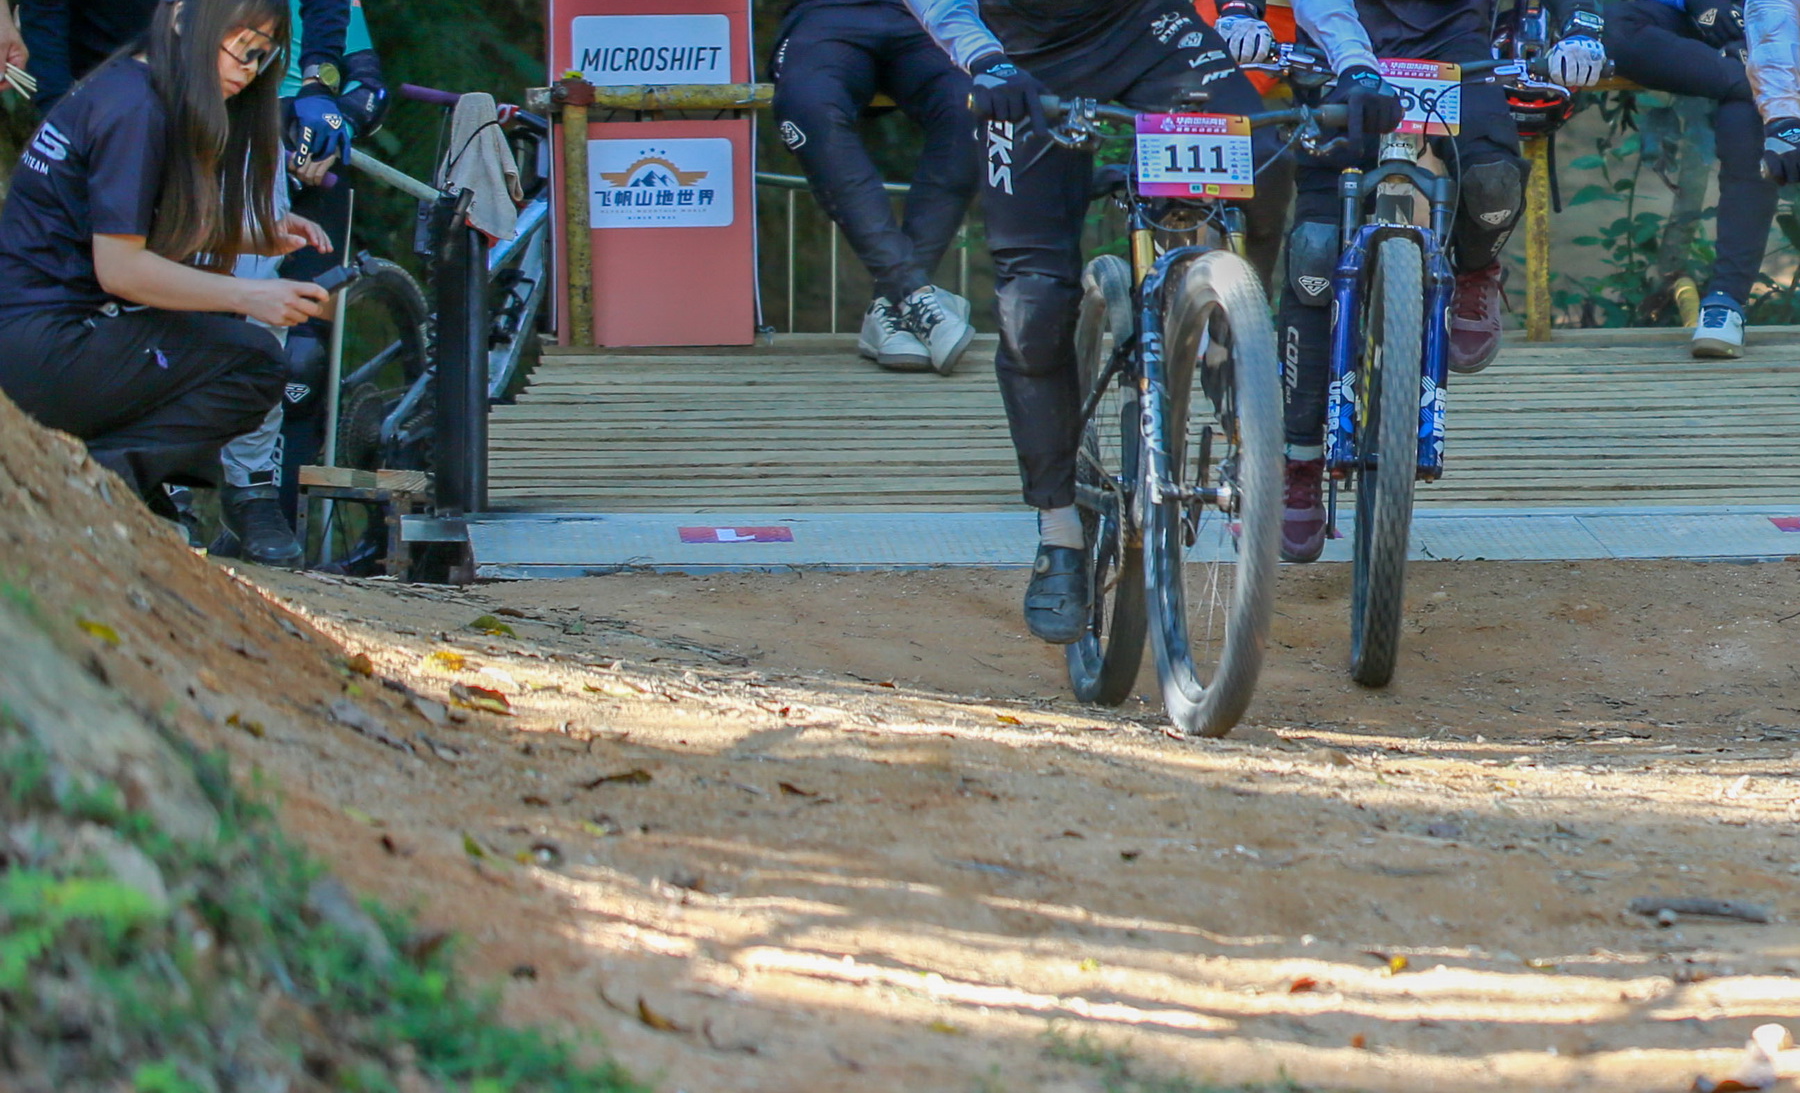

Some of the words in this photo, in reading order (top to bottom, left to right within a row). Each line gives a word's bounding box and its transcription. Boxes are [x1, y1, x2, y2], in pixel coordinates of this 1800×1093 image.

[580, 46, 722, 73] MICROSHIFT
[1164, 144, 1228, 173] 111
[594, 189, 714, 207] 飞帆山地世界
